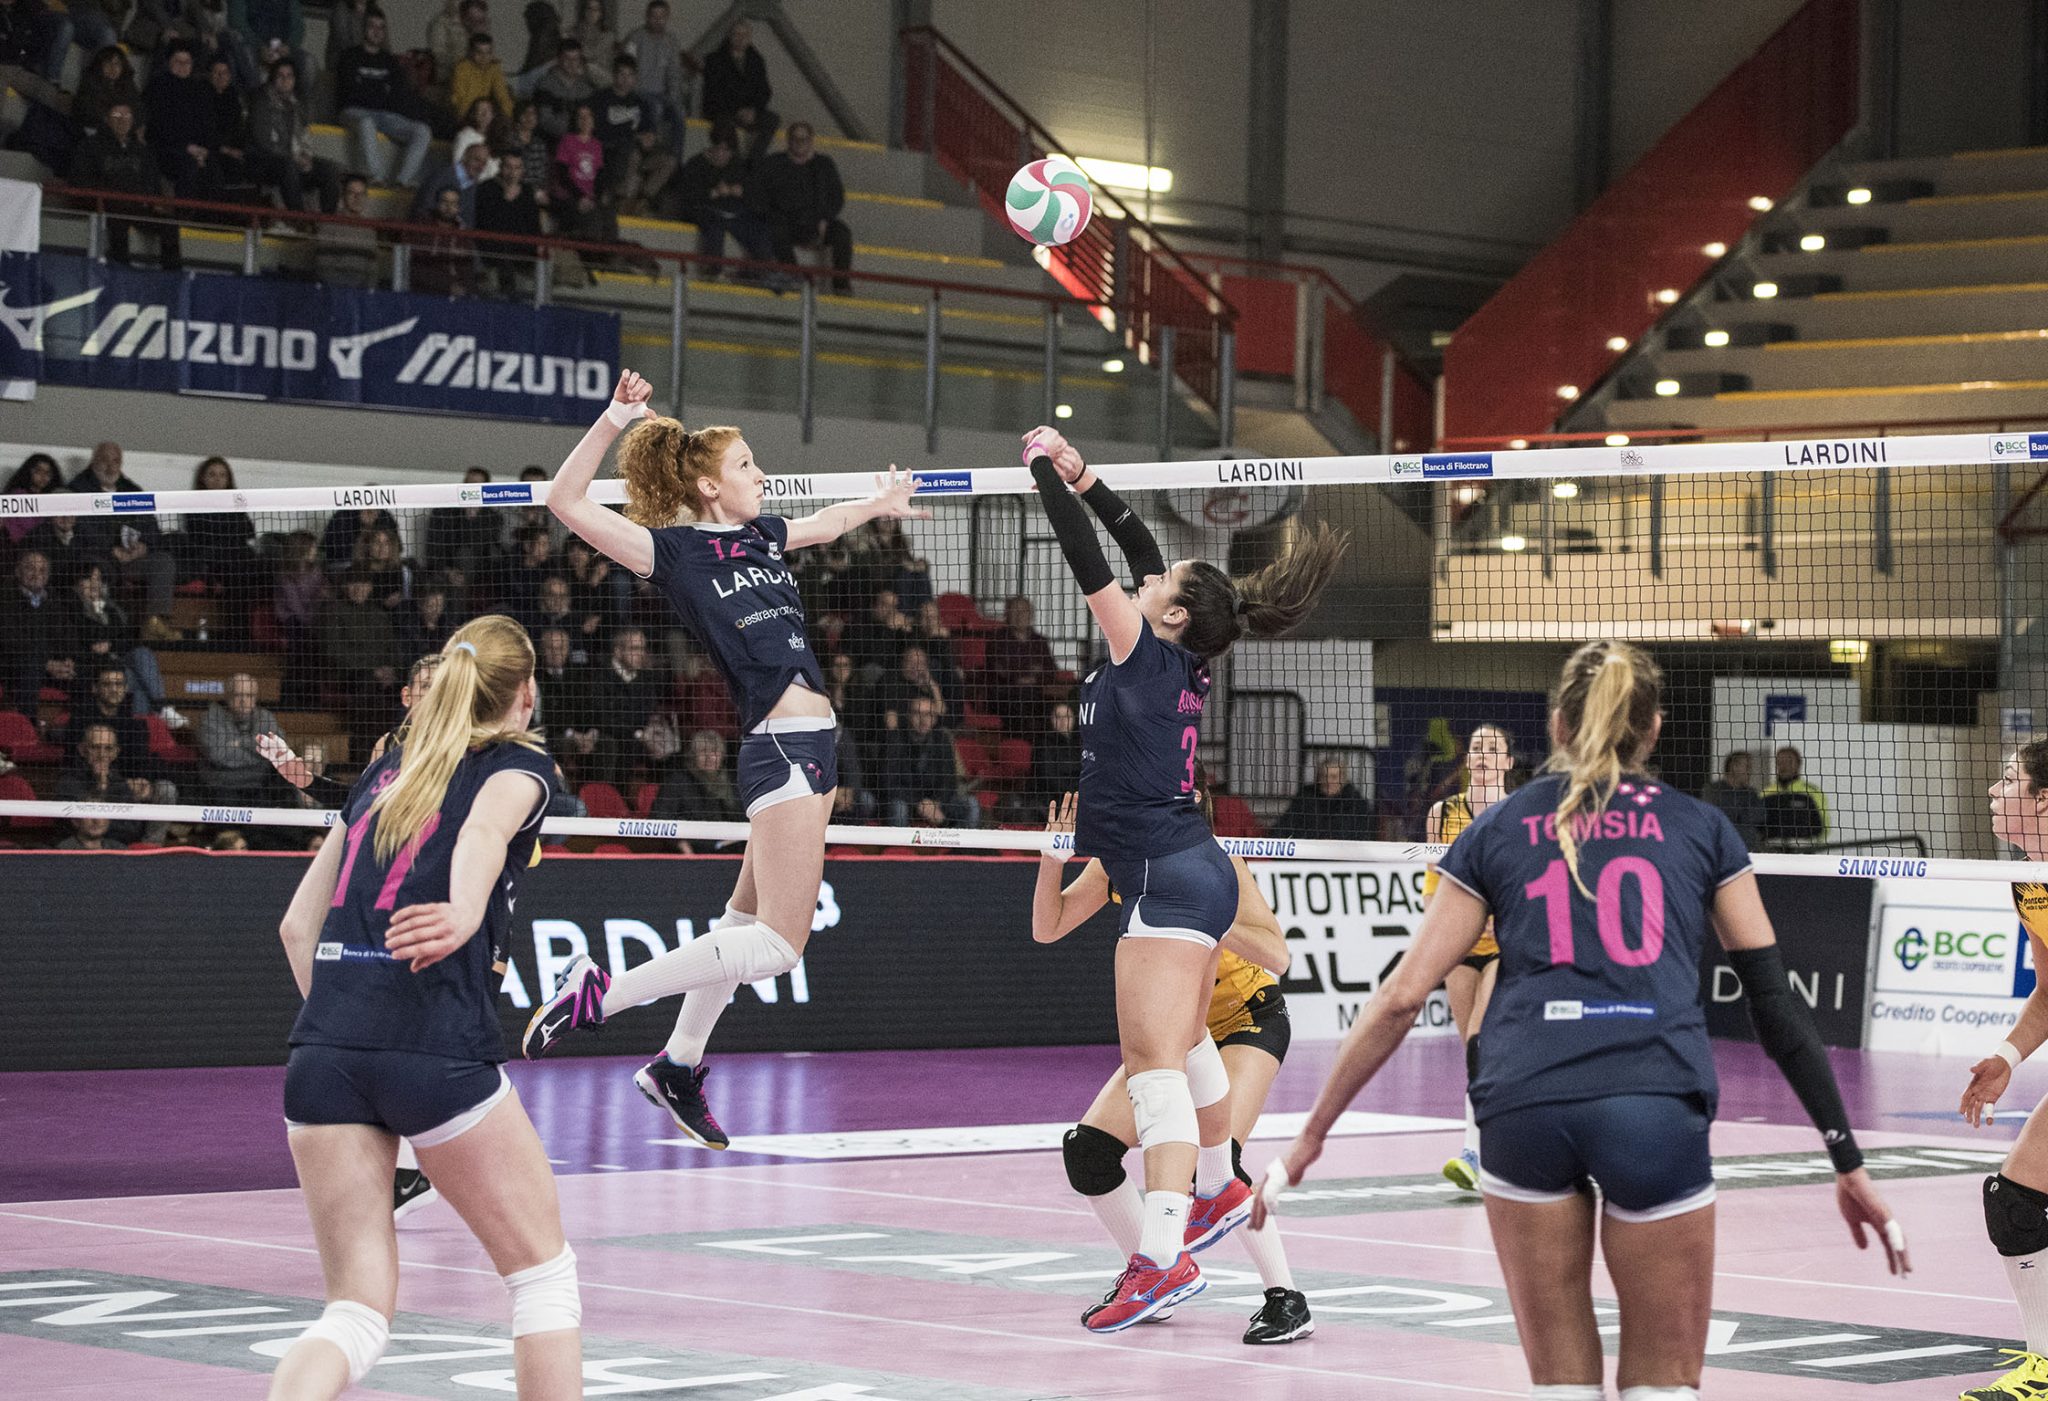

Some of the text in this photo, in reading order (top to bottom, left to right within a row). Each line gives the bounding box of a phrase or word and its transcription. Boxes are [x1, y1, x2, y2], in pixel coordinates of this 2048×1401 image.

[80, 302, 316, 371] MIZUNO
[396, 333, 610, 400] MIZUNO
[1786, 442, 1887, 465] LARDINI
[2005, 441, 2027, 449] BCC
[1218, 461, 1304, 483] LARDINI
[1424, 463, 1445, 471] Banca
[1446, 462, 1453, 470] di
[1454, 461, 1489, 470] Filottrano
[0, 498, 38, 513] RDINI
[334, 489, 396, 506] LARDINI
[1180, 726, 1198, 793] 3
[201, 808, 252, 822] SAMSUNG
[618, 821, 678, 837] SAMSUNG
[1223, 839, 1296, 857] SAMSUNG
[1839, 859, 1927, 878] SAMSUNG
[1525, 856, 1664, 967] 10
[1934, 932, 2006, 958] BCC
[1872, 1001, 1935, 1021] Credito
